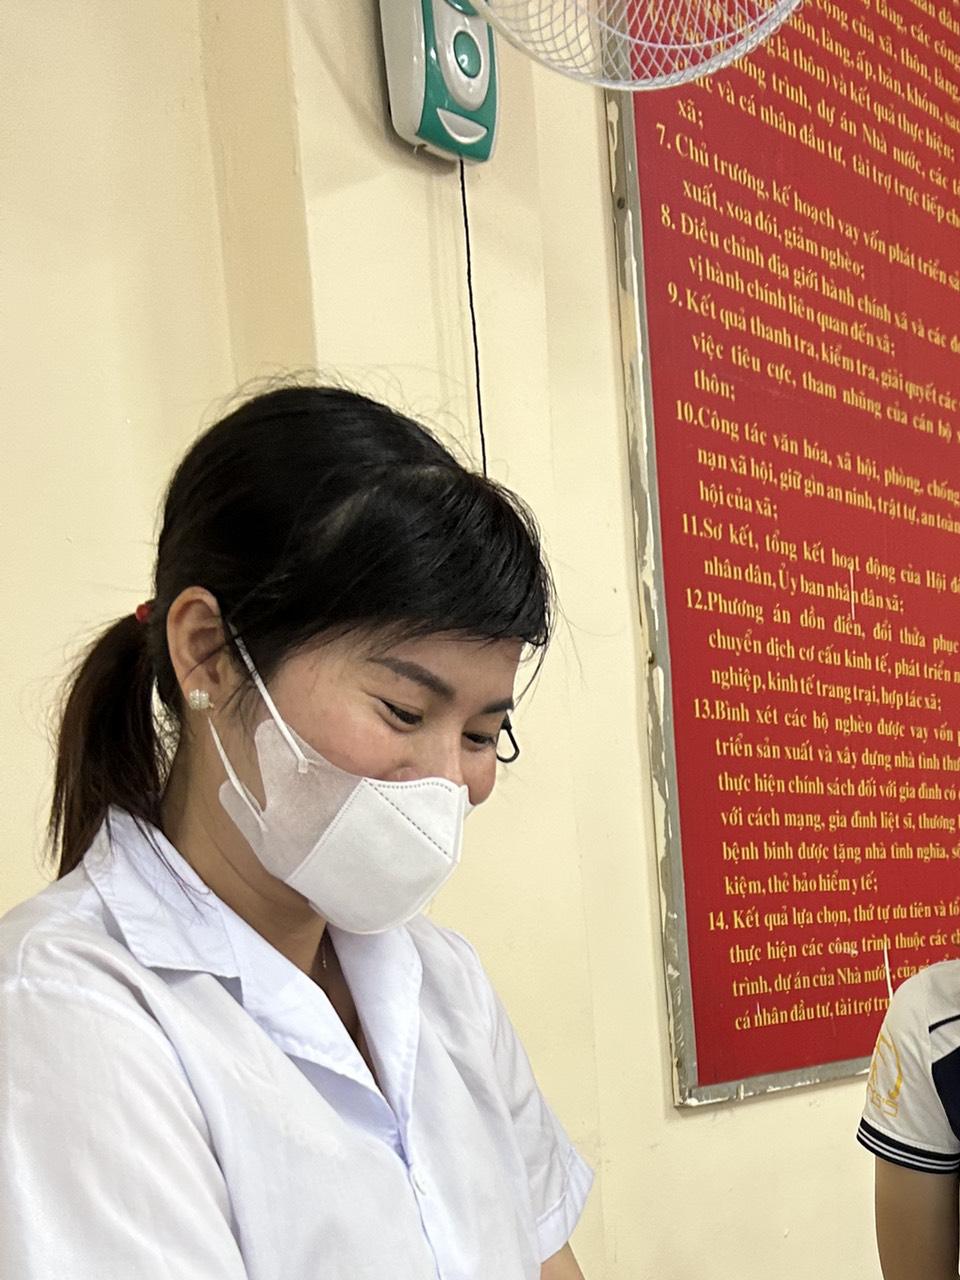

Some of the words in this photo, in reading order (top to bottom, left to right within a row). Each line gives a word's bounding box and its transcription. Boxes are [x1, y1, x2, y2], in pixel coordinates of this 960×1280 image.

[676, 98, 704, 130] xã;
[692, 367, 736, 402] thôn;
[698, 478, 725, 507] hội
[725, 486, 753, 513] của
[754, 495, 778, 521] xã;
[723, 874, 767, 899] kiệm,
[766, 870, 790, 894] thẻ
[791, 870, 818, 893] bảo
[817, 868, 851, 892] hiểm
[850, 877, 858, 896] y
[859, 869, 878, 893] tế;
